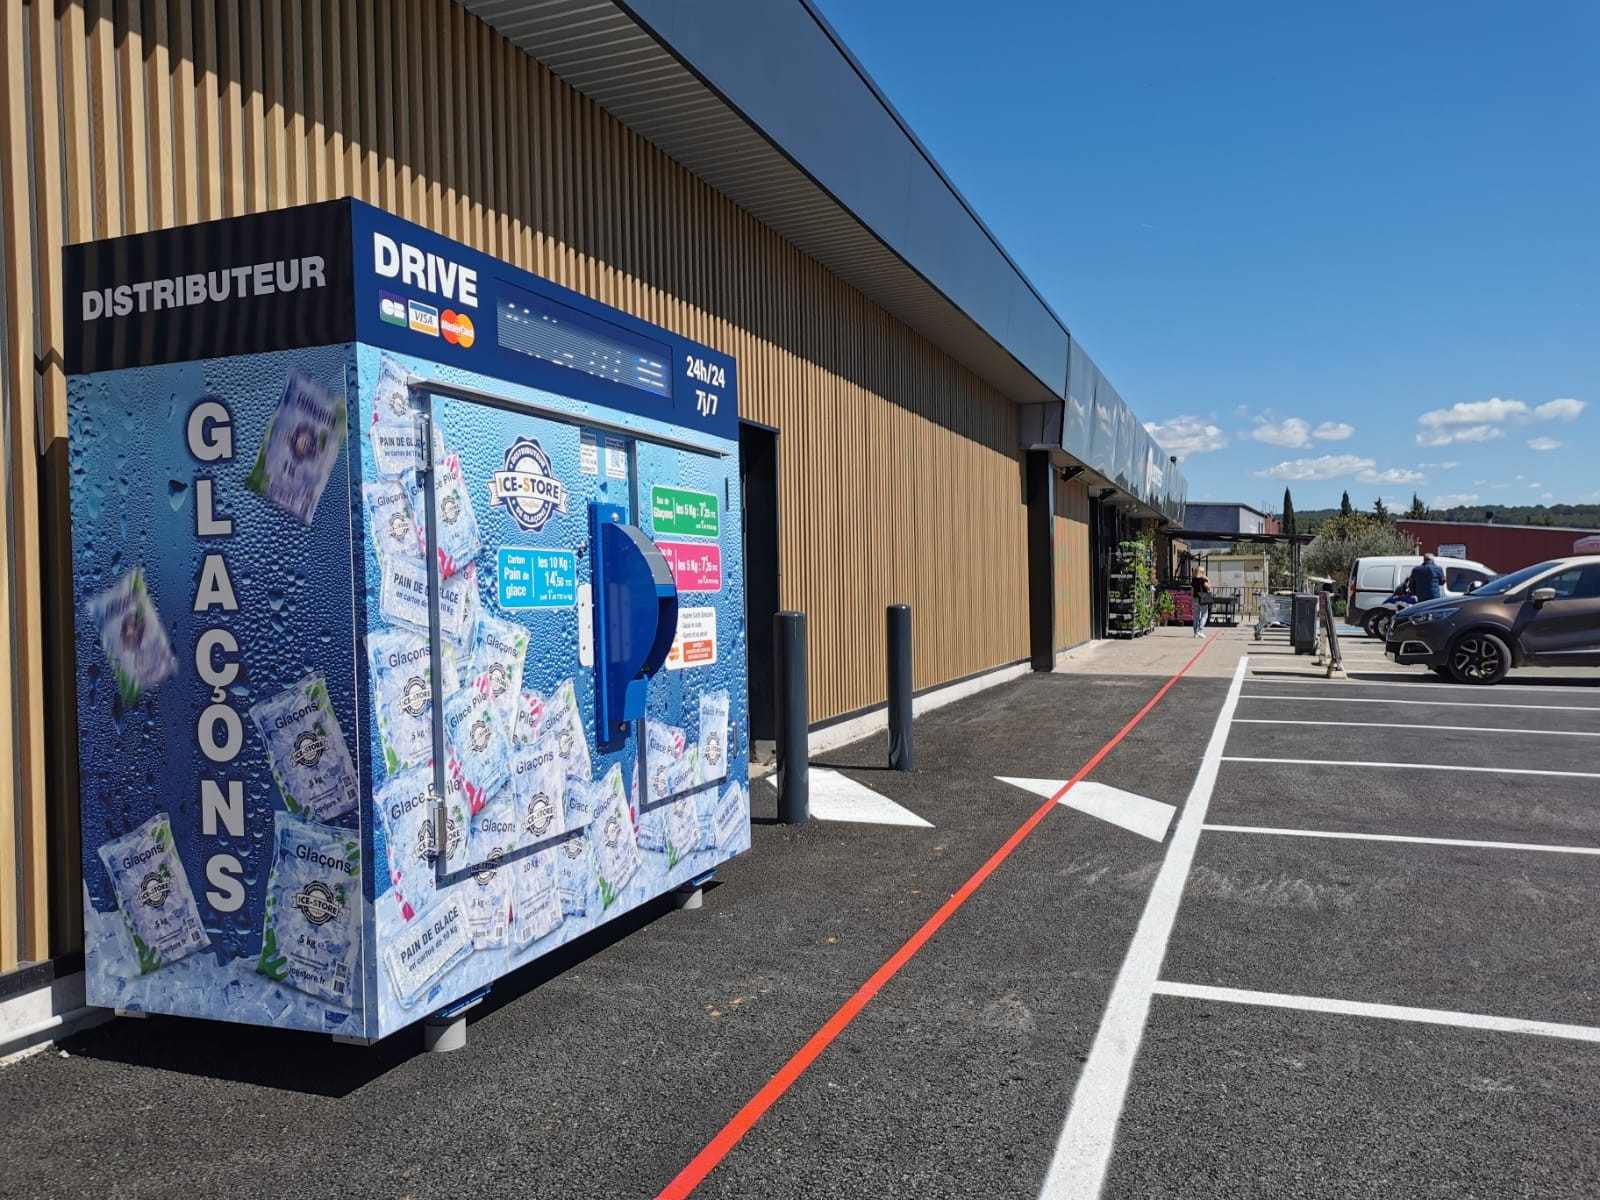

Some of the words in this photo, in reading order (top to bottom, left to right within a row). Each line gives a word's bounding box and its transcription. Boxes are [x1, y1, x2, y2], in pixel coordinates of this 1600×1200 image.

[374, 232, 478, 308] DRIVE
[82, 255, 326, 321] DISTRIBUTEUR
[414, 311, 434, 325] VISA
[686, 355, 726, 389] 24h/24
[695, 389, 718, 416] 7j/7
[498, 476, 560, 499] ICE-STORE
[684, 503, 689, 516] 5
[503, 567, 521, 580] Pain
[537, 556, 549, 569] les
[549, 557, 558, 569] 10
[558, 557, 568, 572] Kg
[686, 560, 691, 571] 5
[394, 573, 412, 590] PAIN
[414, 580, 424, 593] DE
[505, 583, 527, 599] glace
[187, 400, 247, 914] GLAÇONS
[388, 645, 431, 668] Glaçons
[486, 634, 518, 658] Glaçons
[275, 701, 318, 729] Glaçons
[450, 705, 472, 728] Glace
[545, 704, 570, 730] Glaçons
[516, 751, 554, 775] Glaçons
[391, 794, 426, 820] Glace
[593, 790, 618, 819] Glaçons
[122, 842, 163, 870] Glaçons
[296, 843, 351, 874] Glaçons
[523, 862, 530, 874] 10
[297, 894, 338, 916] ICE-STORE
[299, 934, 306, 944] 5
[305, 935, 316, 949] kg
[399, 942, 422, 964] PAIN
[421, 931, 434, 948] DE
[434, 906, 460, 935] GLACE
